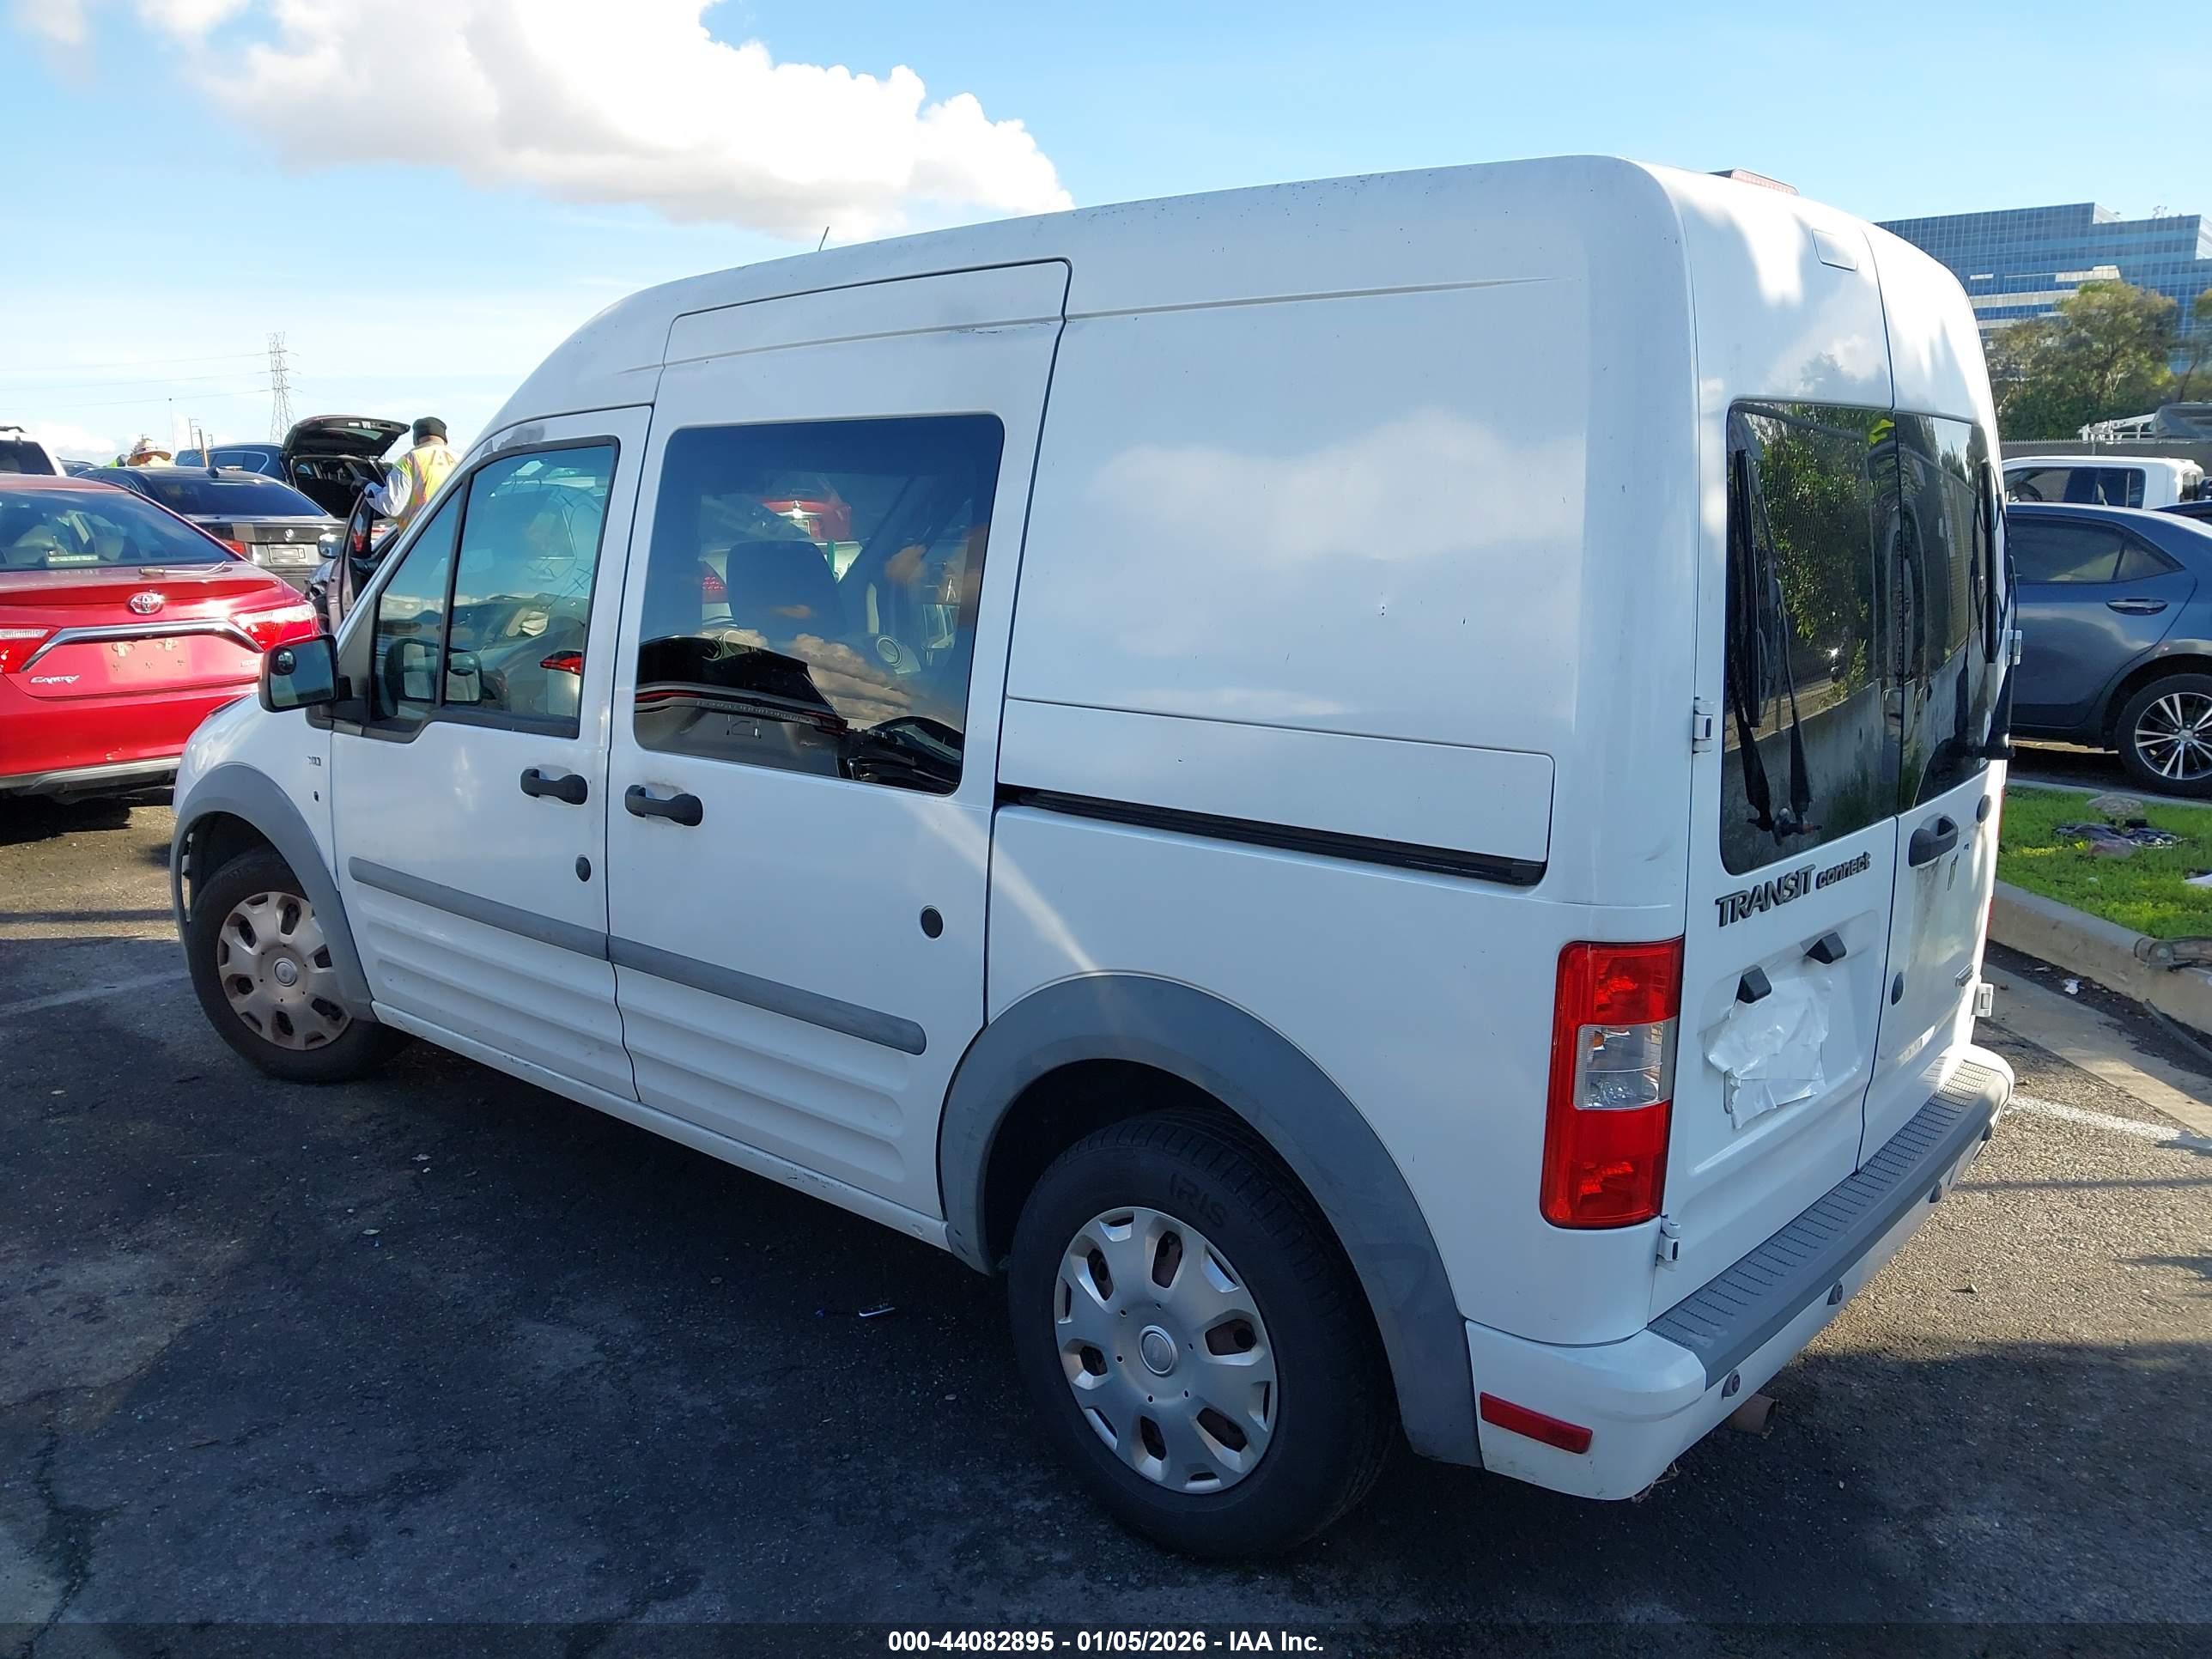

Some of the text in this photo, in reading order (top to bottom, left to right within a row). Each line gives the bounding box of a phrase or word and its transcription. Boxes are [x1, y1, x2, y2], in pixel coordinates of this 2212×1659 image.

[1715, 851, 1871, 927] TRANSIT connect
[1169, 1171, 1227, 1228] IRIS
